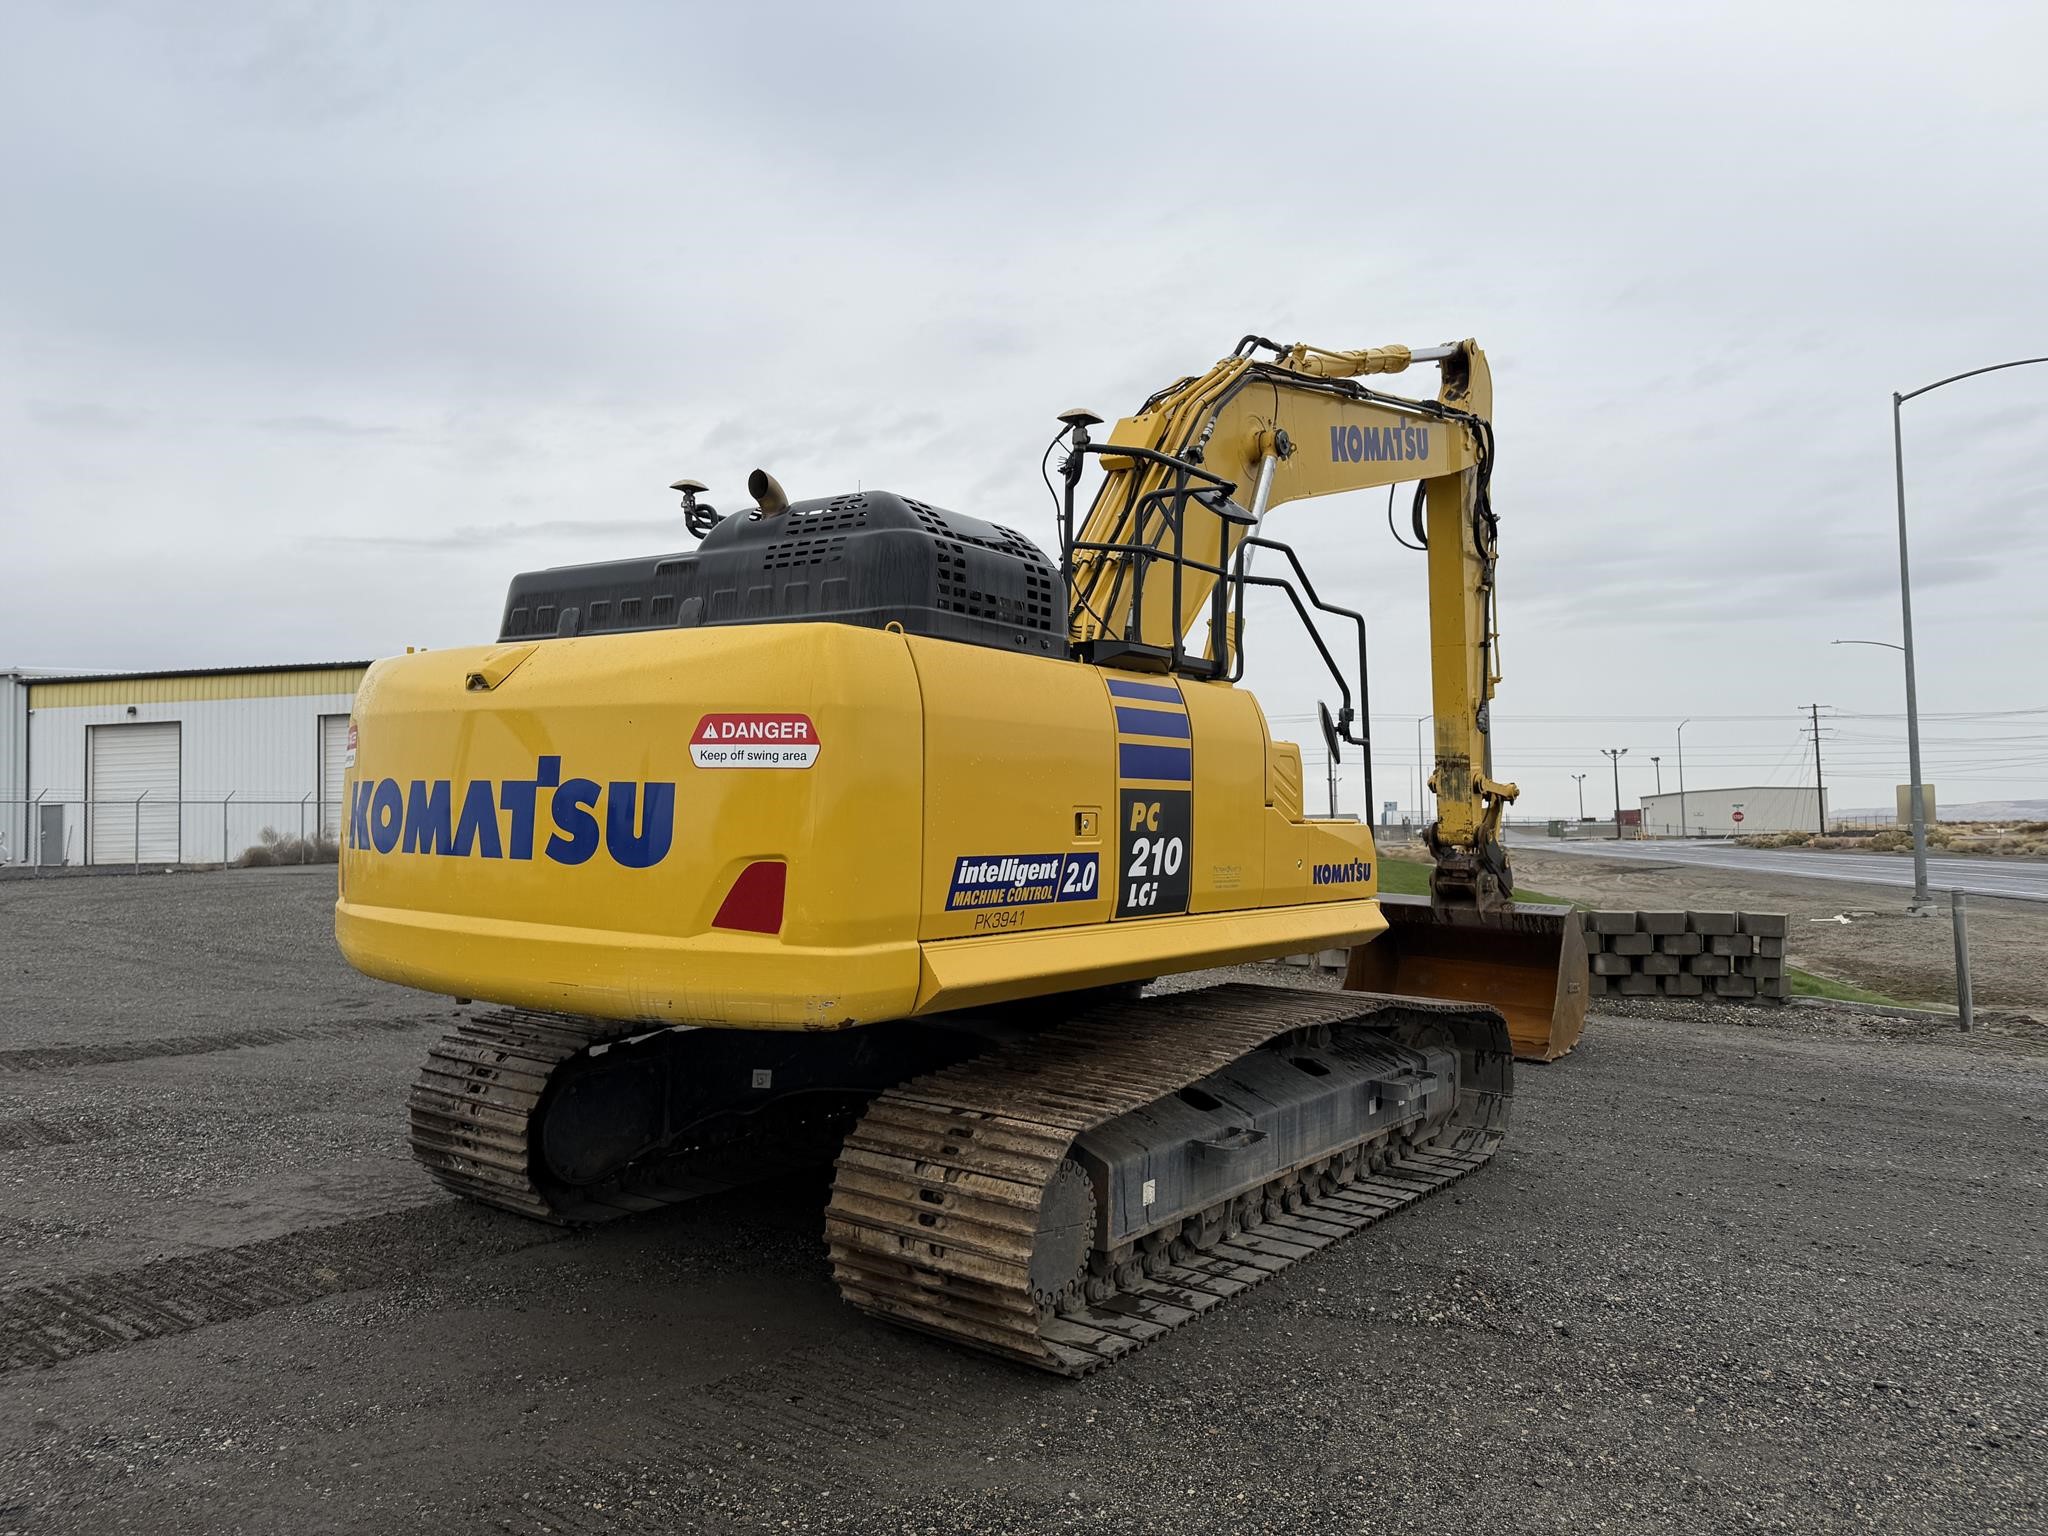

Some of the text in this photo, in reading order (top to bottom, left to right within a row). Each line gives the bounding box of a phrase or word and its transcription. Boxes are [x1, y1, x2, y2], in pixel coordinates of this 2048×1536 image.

[1330, 416, 1428, 463] KOMATSU
[722, 722, 808, 738] DANGER
[700, 750, 807, 763] Keep off swing area
[349, 755, 676, 869] KOMATSU
[1130, 802, 1160, 832] PC
[1128, 837, 1183, 877] 210
[1313, 857, 1371, 885] KOMATSU
[958, 859, 1097, 893] intelligent 2.0
[952, 886, 1053, 907] MACHINE CONTROL
[974, 910, 1025, 930] PK3941
